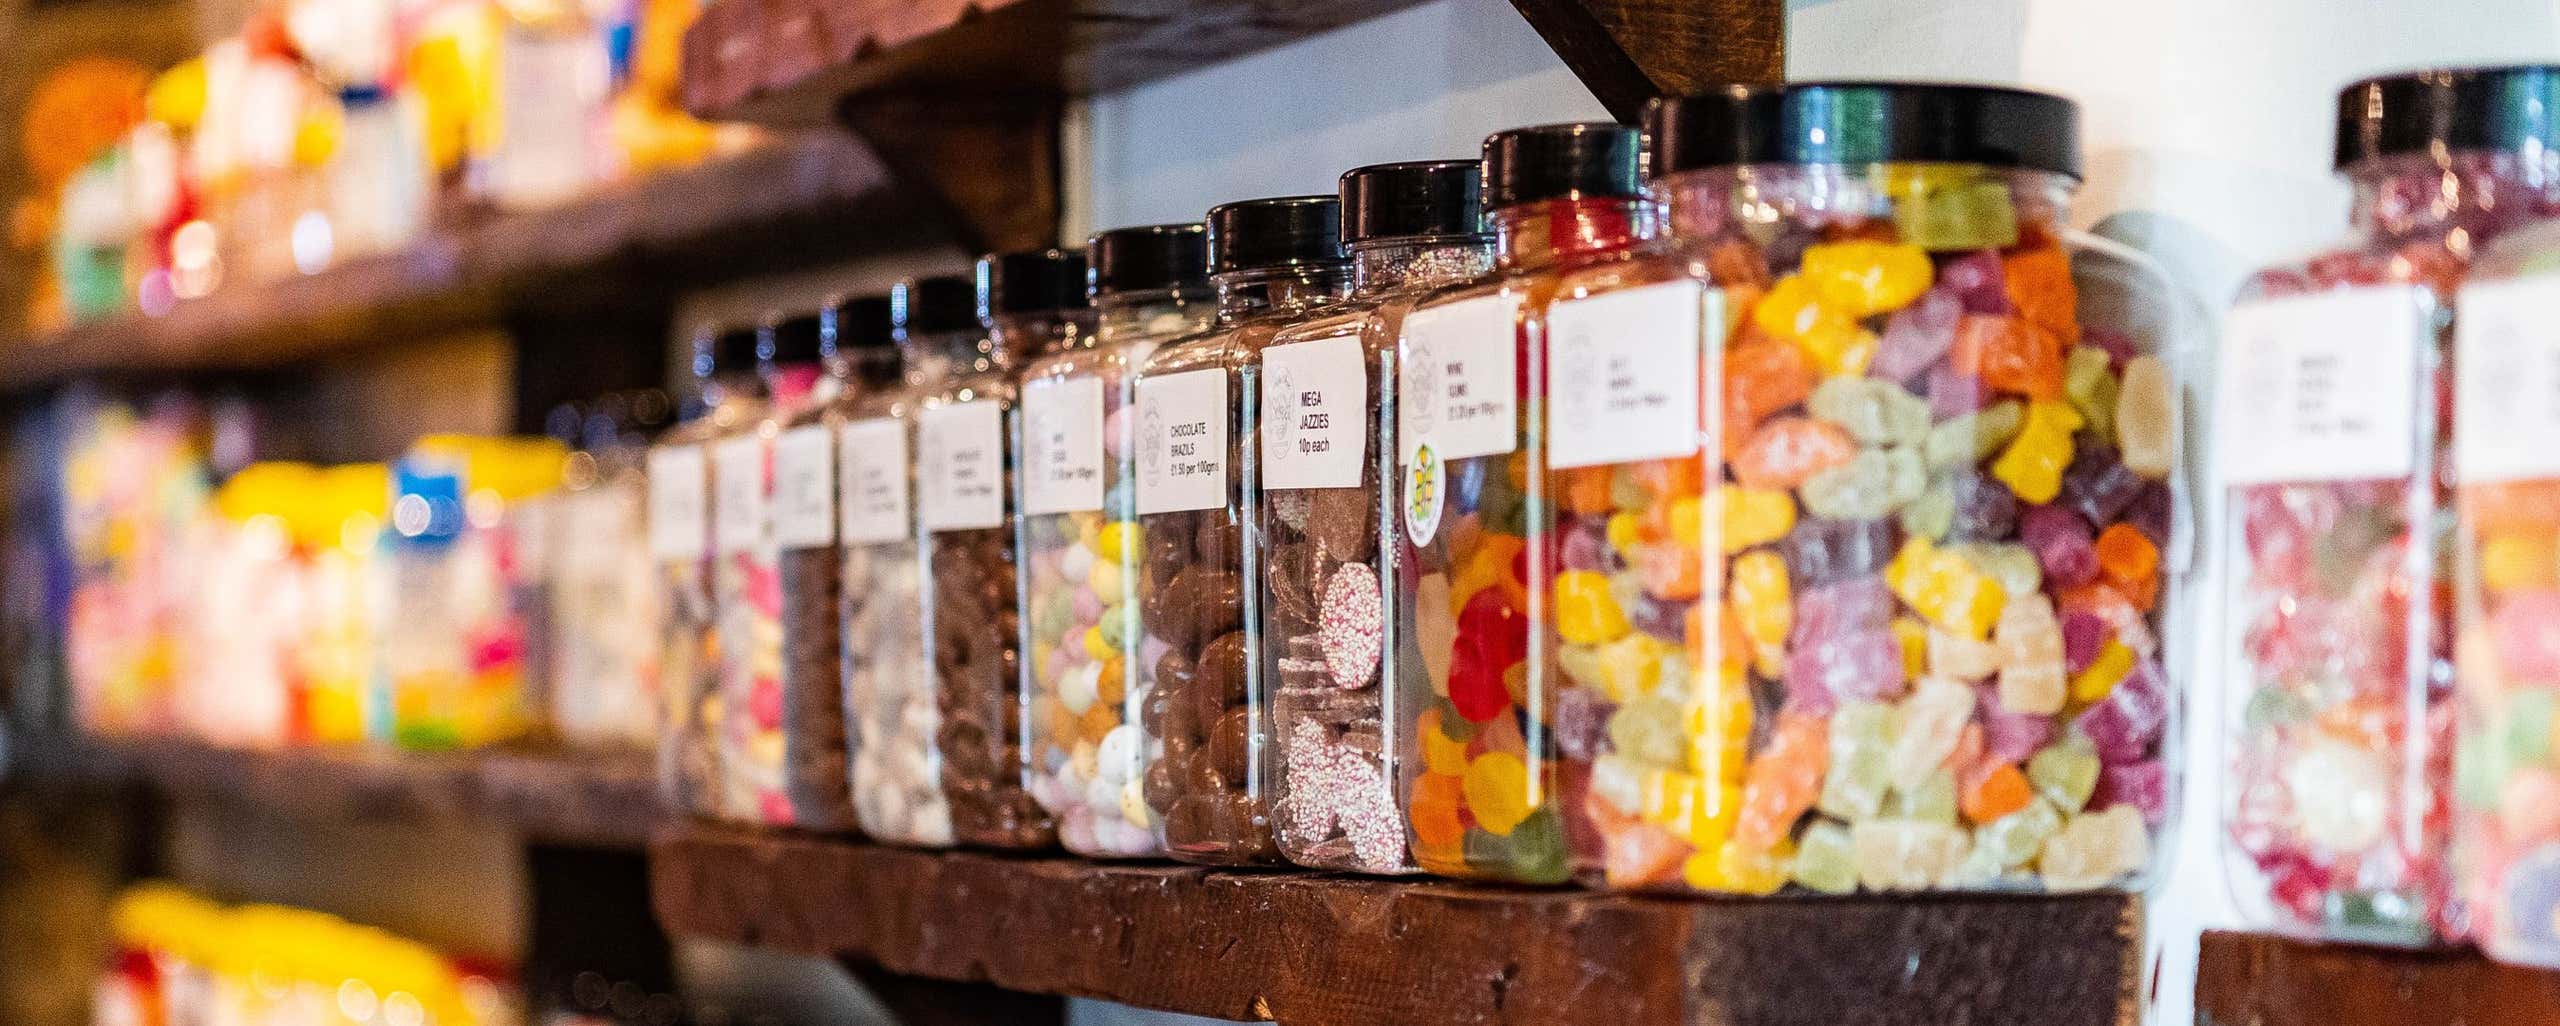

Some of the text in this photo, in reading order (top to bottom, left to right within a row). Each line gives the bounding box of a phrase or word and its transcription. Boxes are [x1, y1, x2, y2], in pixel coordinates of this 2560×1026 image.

[1301, 391, 1322, 407] MEGA
[1299, 413, 1329, 430] JAZZIES
[1170, 422, 1206, 437] CHOCOLATE
[1170, 442, 1195, 457] BRAZILS
[1299, 436, 1330, 456] 10p each
[1186, 464, 1196, 477] per
